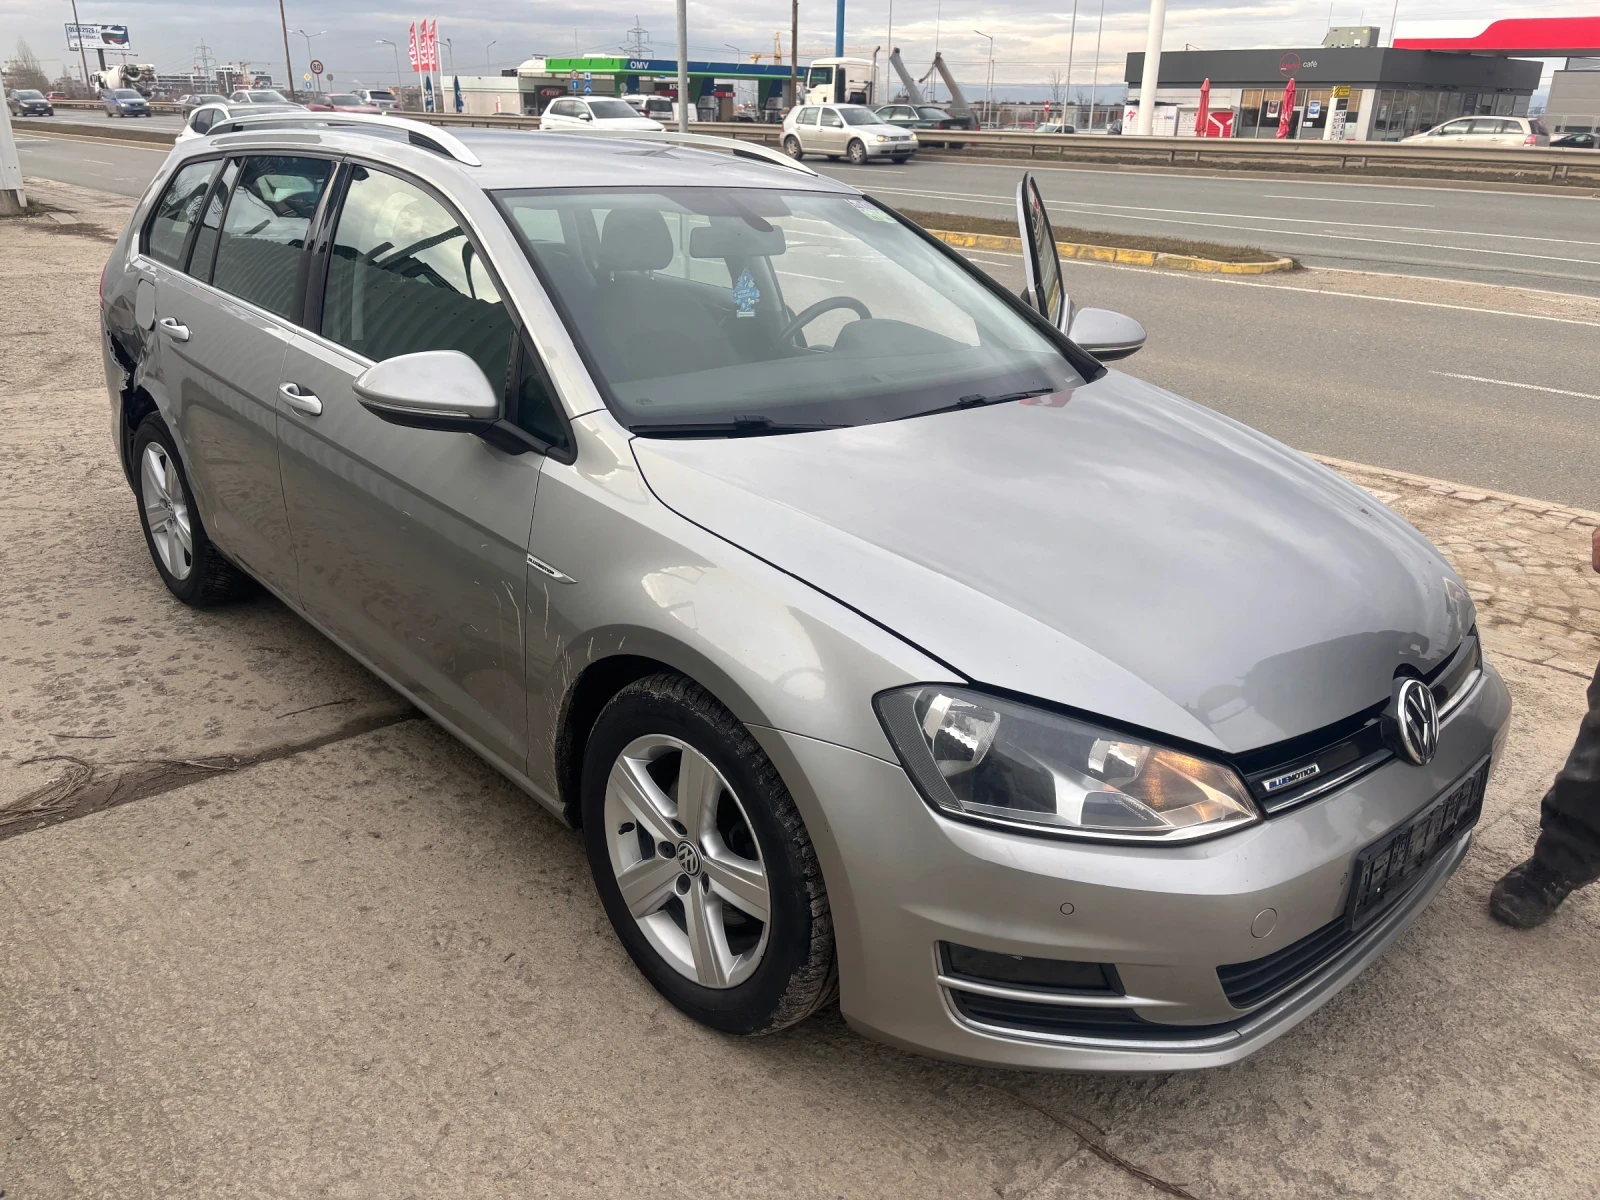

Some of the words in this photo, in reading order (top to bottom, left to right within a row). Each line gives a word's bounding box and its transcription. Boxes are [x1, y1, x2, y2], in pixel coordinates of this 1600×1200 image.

[313, 63, 321, 71] 80
[630, 61, 649, 69] OMV
[1302, 60, 1318, 68] café
[1269, 765, 1317, 789] BLUEMOTION
